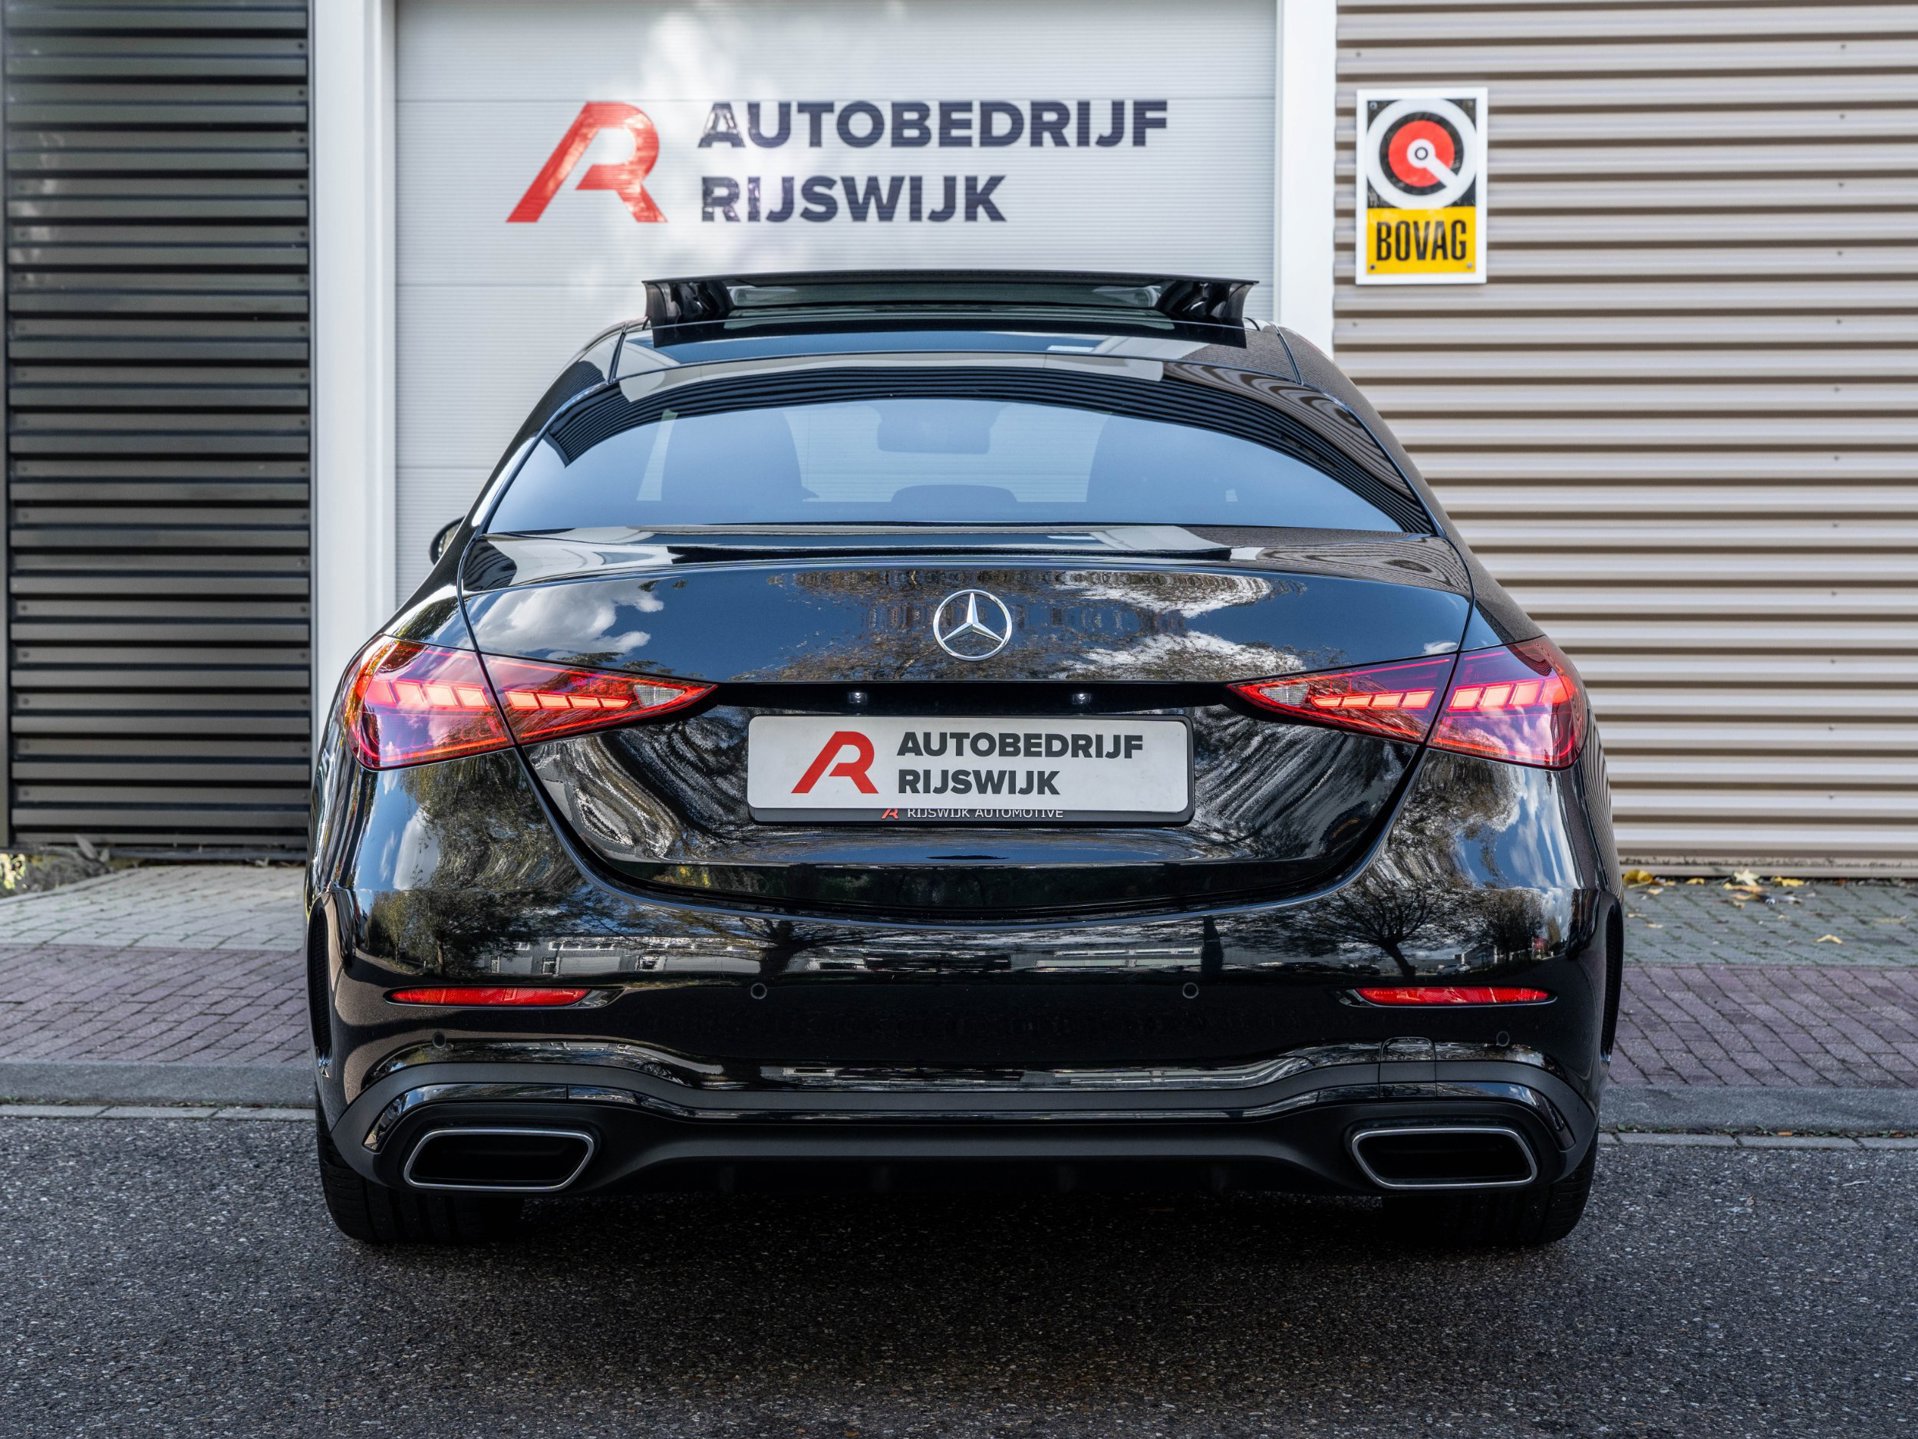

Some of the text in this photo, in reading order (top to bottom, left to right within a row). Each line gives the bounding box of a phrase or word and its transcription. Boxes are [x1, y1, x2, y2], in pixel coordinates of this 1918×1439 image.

[698, 100, 1168, 148] AUTOBEDRIJF
[701, 175, 1007, 222] RIJSWIJK
[1376, 219, 1467, 261] BOVAG
[897, 731, 1143, 759] AUTOBEDRIJF
[898, 769, 1060, 795] RIJSWIJK
